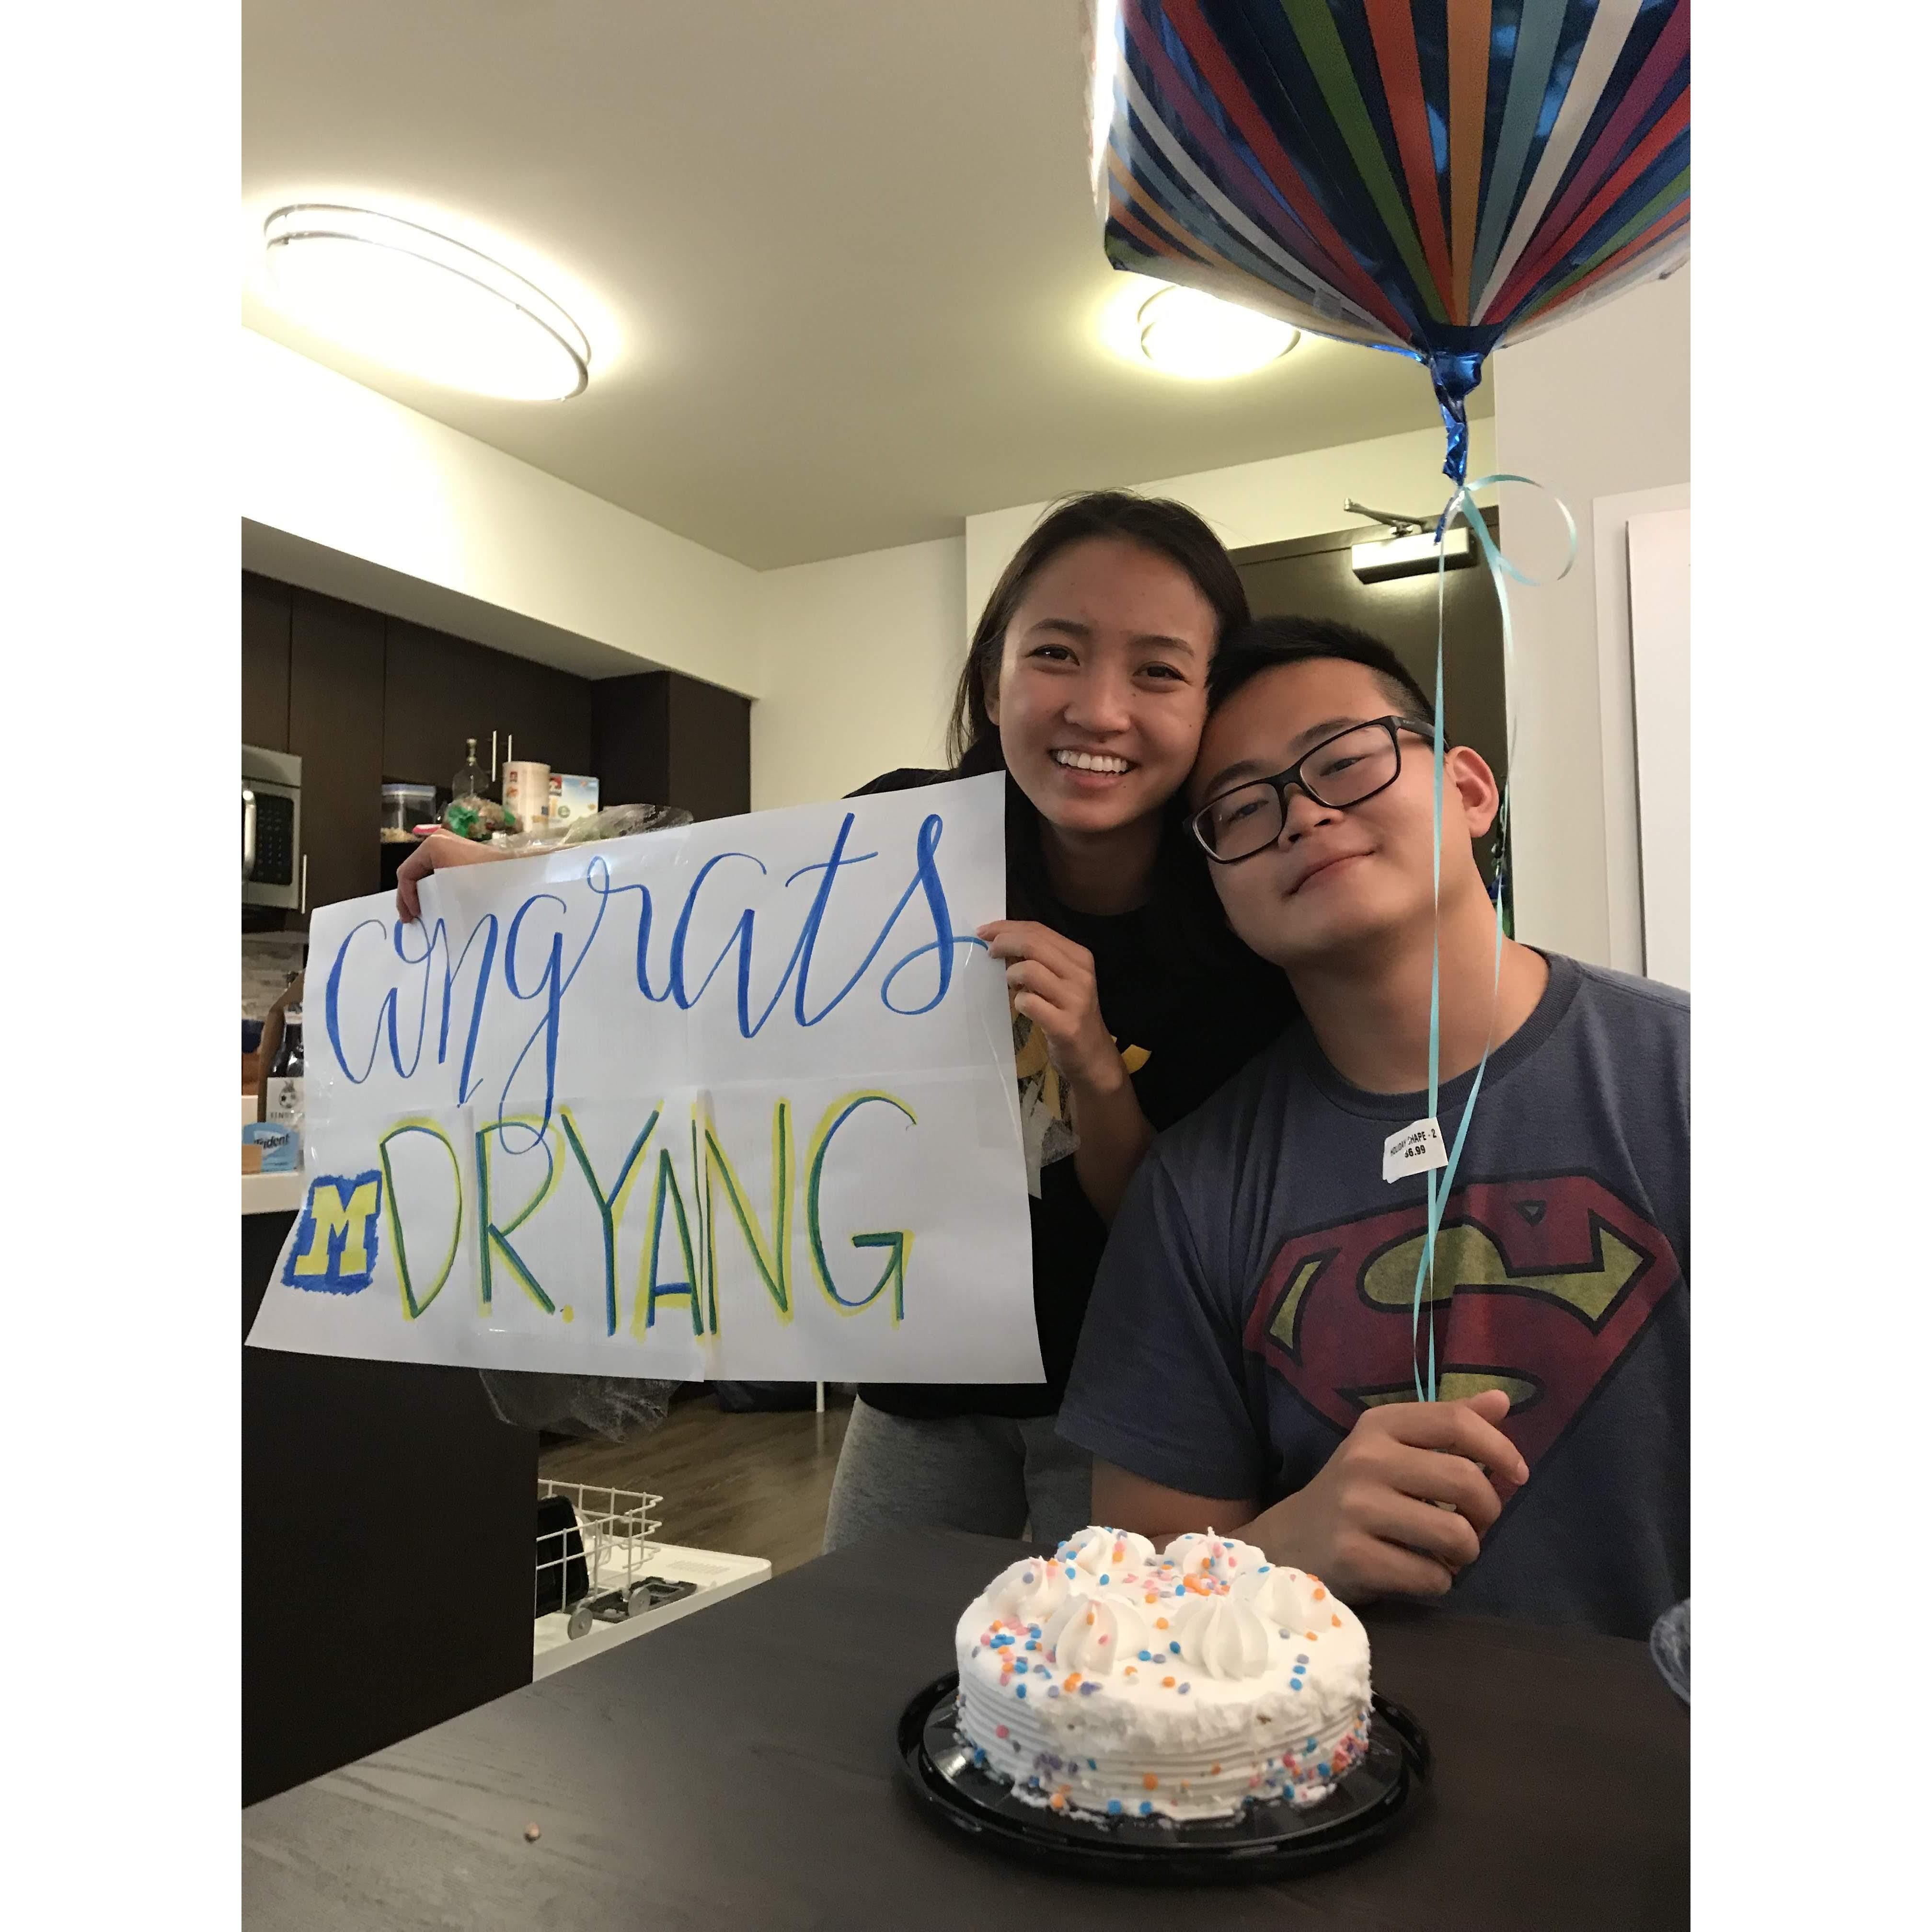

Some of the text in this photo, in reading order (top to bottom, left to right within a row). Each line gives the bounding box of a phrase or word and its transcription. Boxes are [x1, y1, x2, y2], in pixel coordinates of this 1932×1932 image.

[1407, 1131, 1426, 1145] SHAPE
[1431, 1128, 1437, 1138] 2
[1404, 1145, 1426, 1158] $6.99
